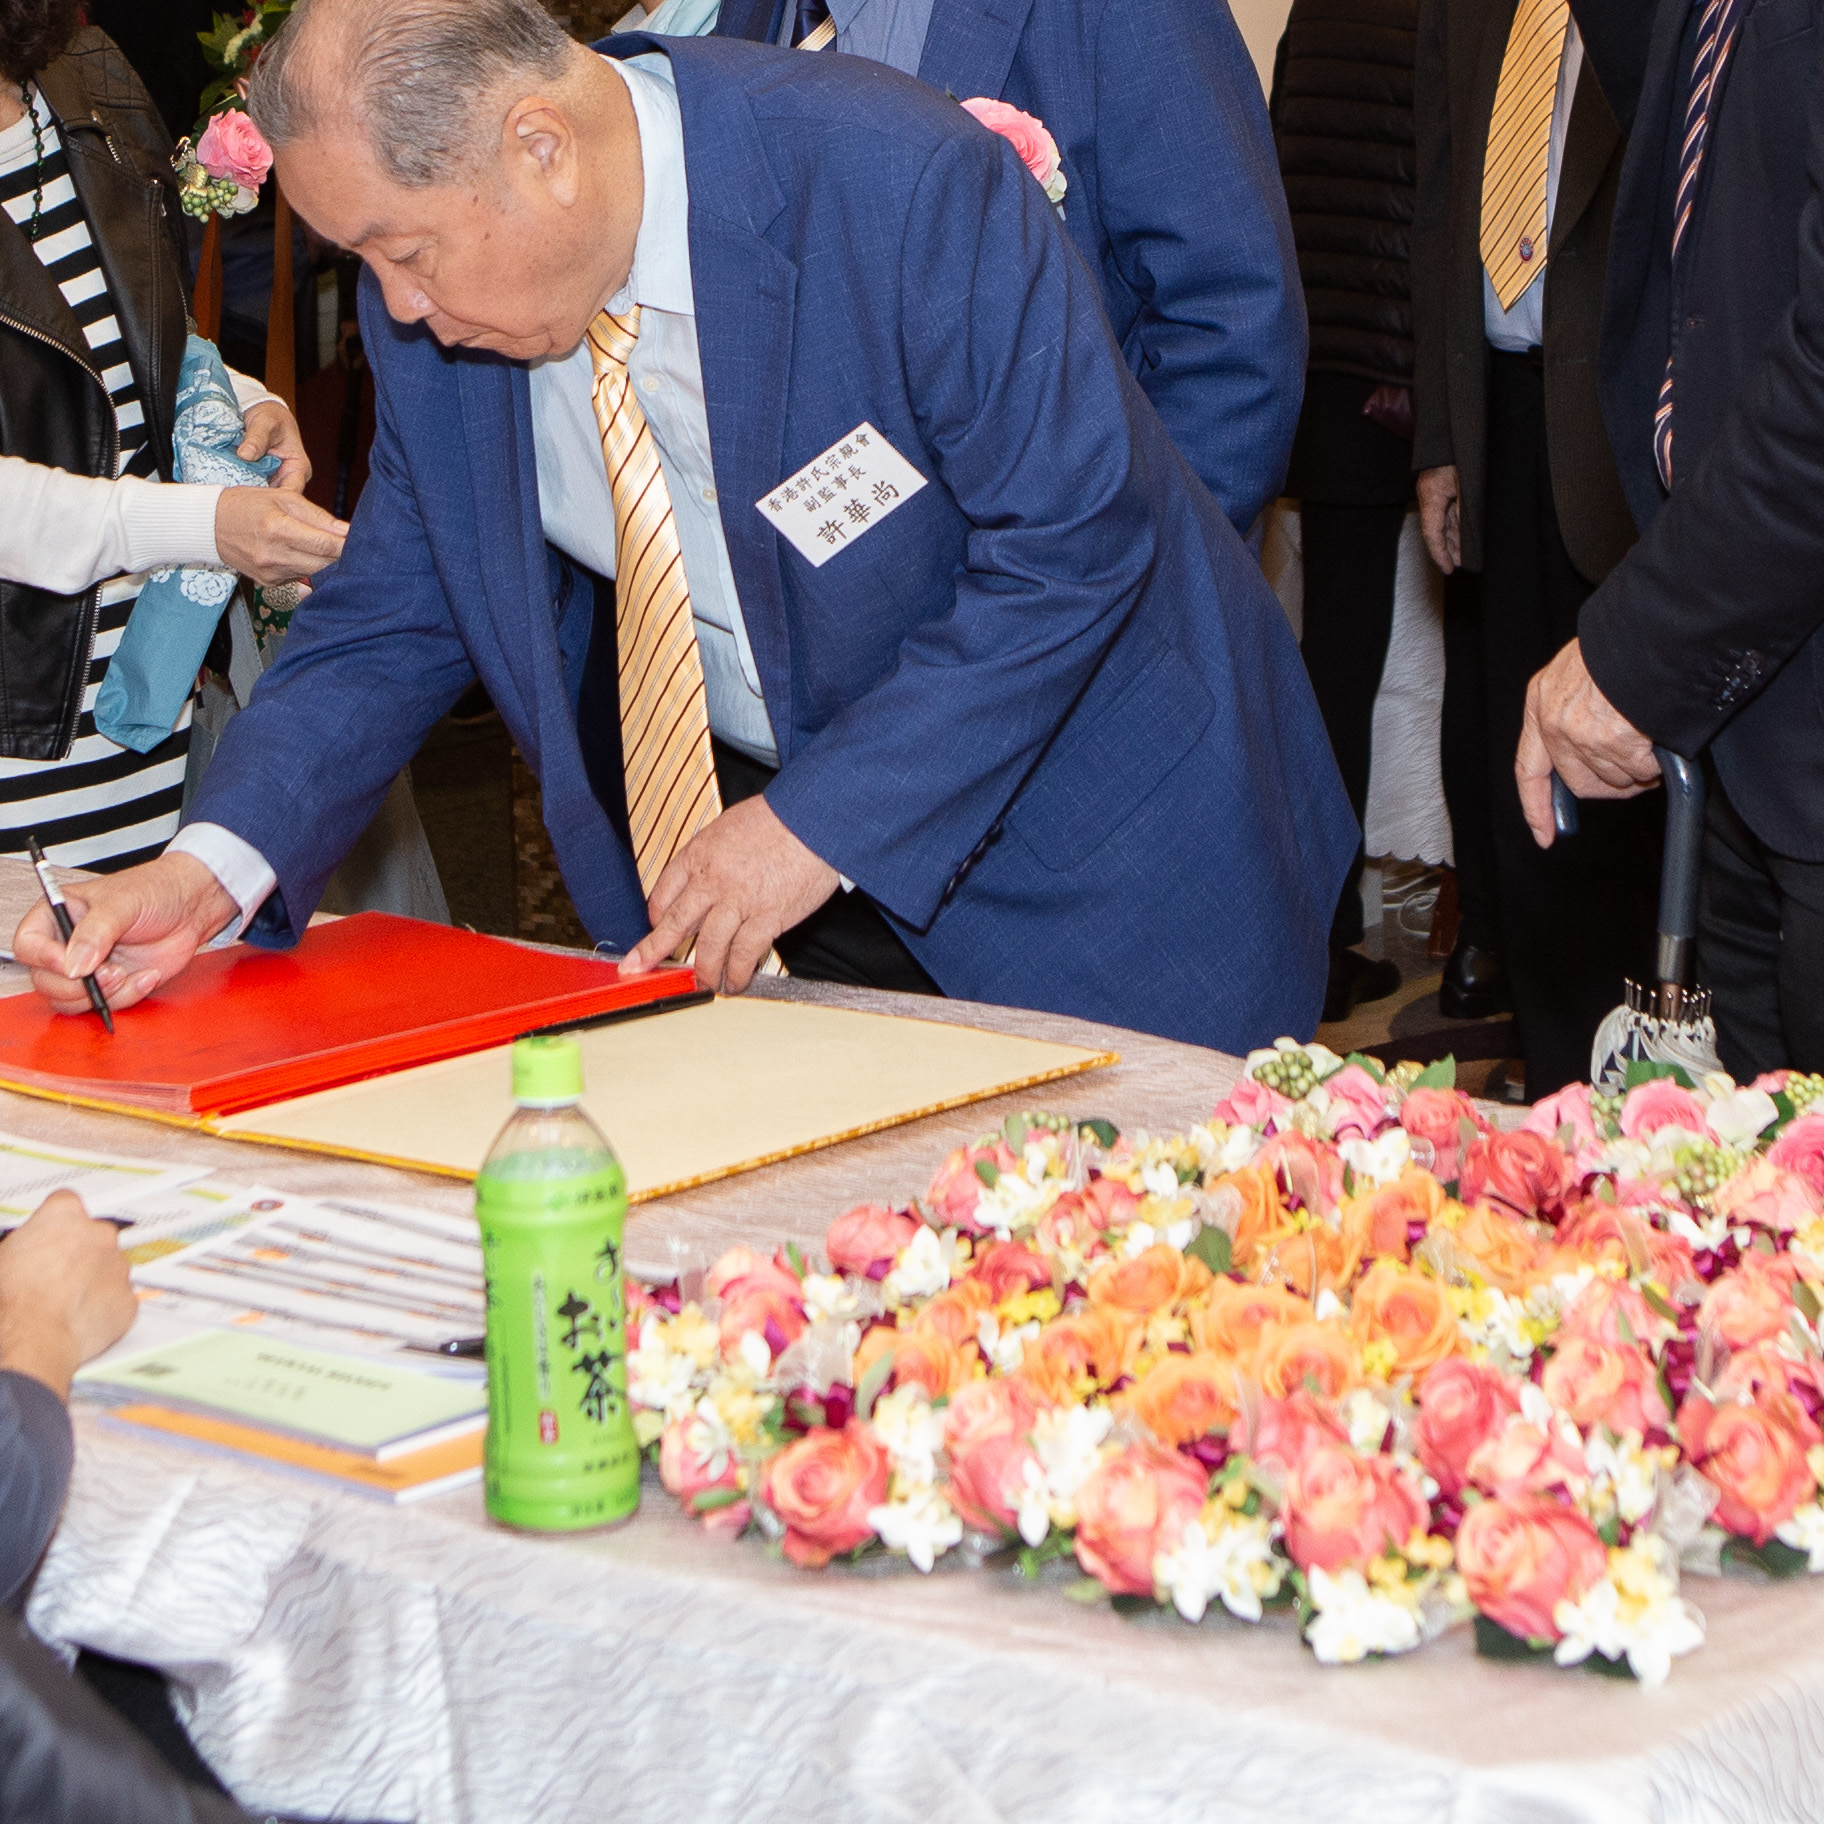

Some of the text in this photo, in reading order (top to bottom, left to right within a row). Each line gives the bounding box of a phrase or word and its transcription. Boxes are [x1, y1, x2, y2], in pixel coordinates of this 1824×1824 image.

[766, 432, 871, 513] 香港許氏宗親會
[803, 464, 868, 513] 副監事長
[816, 480, 900, 545] 許華尚
